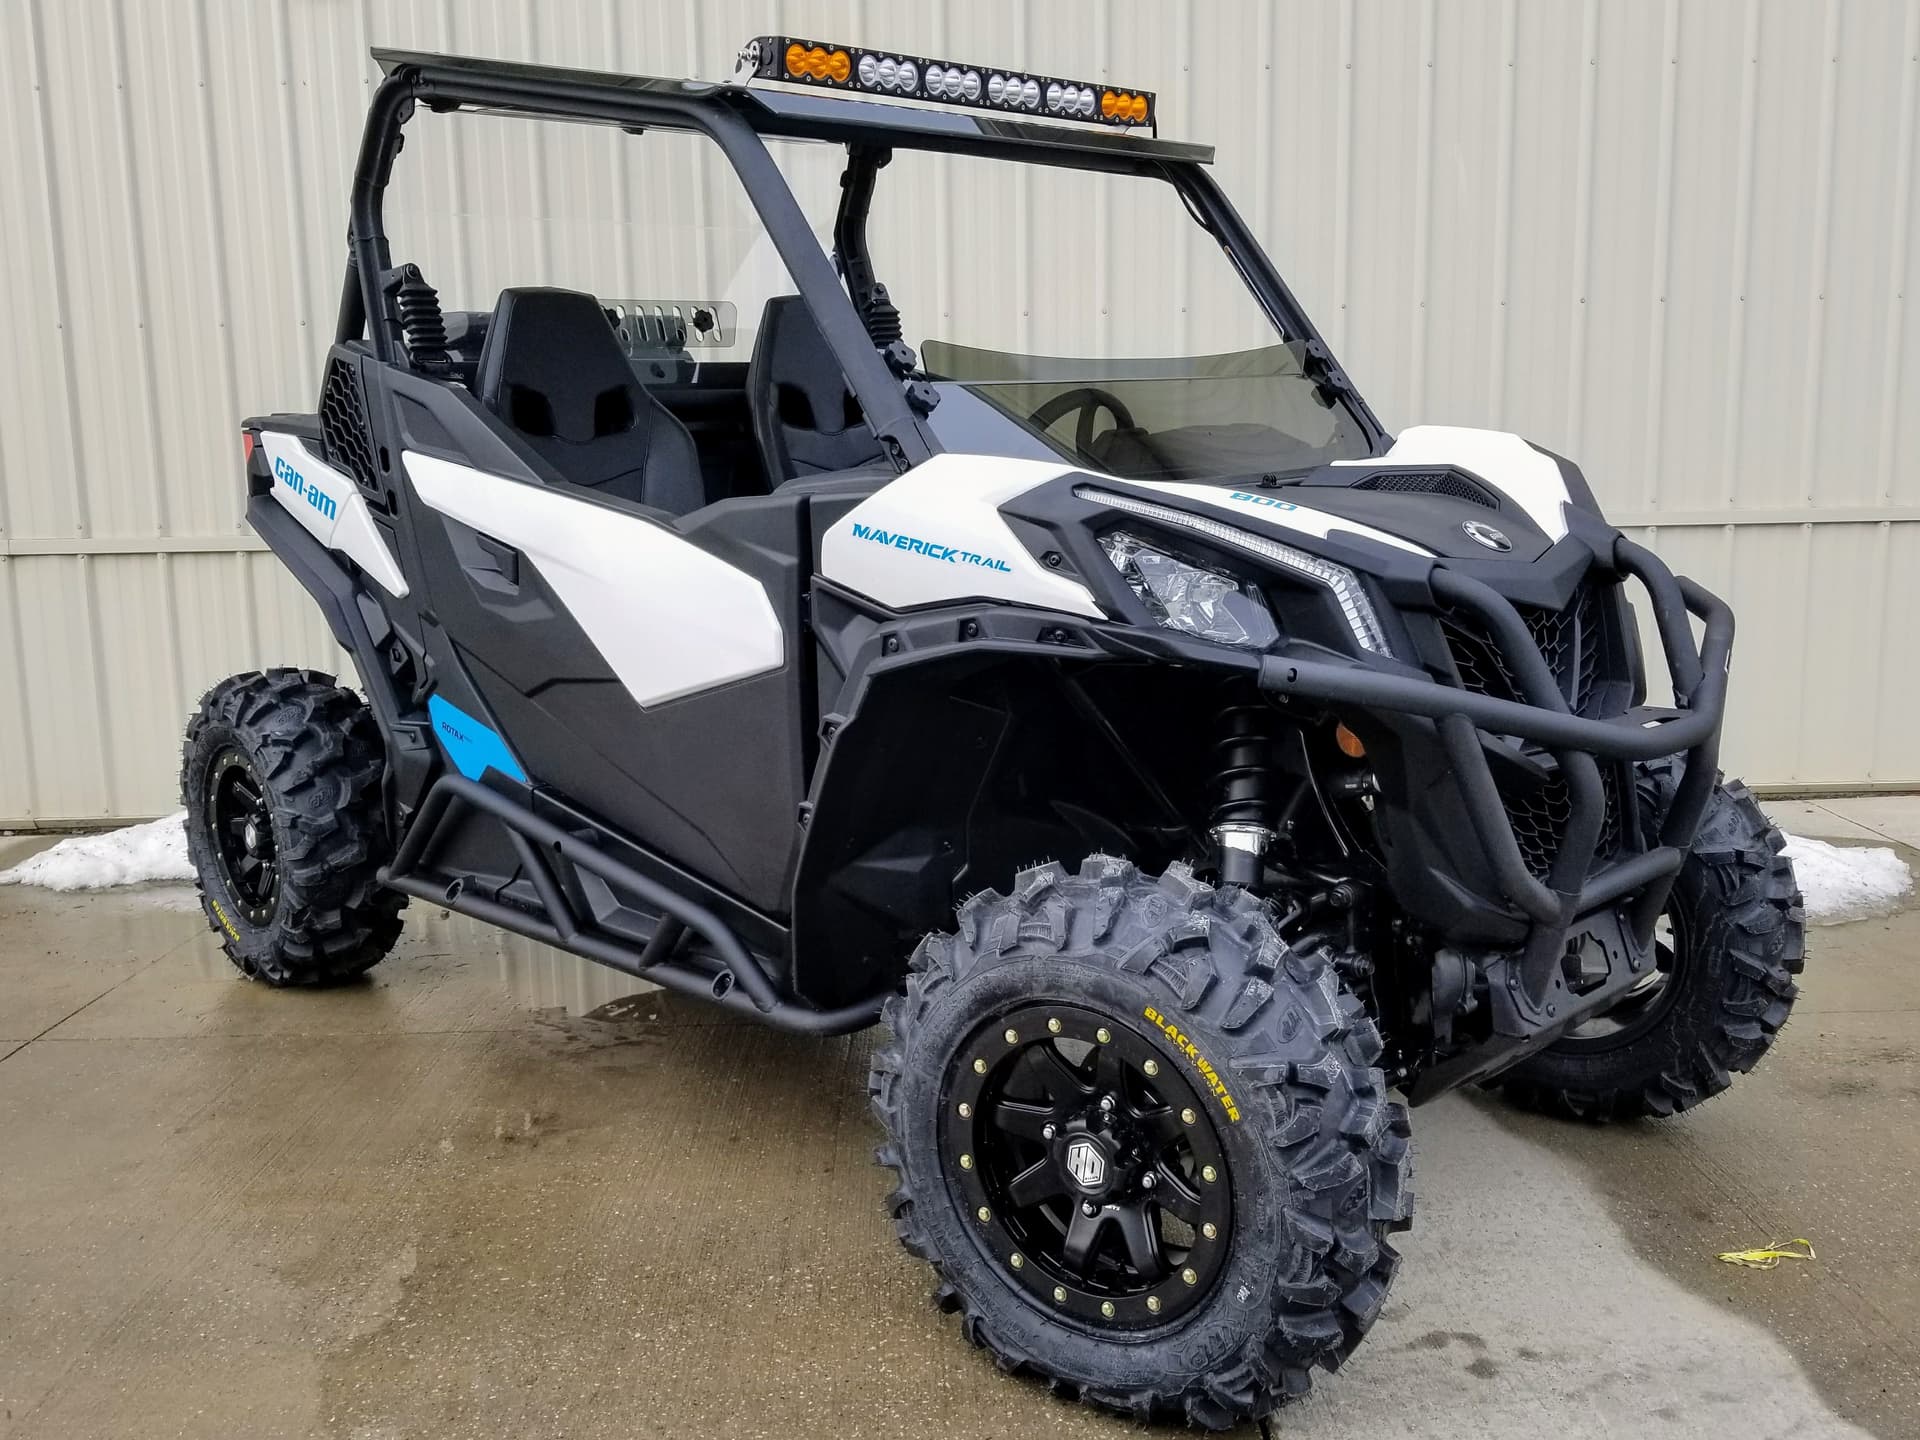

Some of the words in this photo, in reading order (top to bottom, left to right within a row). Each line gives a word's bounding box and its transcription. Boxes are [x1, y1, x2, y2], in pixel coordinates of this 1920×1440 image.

[275, 456, 337, 521] can-am
[1229, 491, 1297, 512] 800
[852, 523, 959, 563] MAVERICK
[961, 551, 1012, 573] TRAIL
[1070, 1146, 1102, 1182] HD
